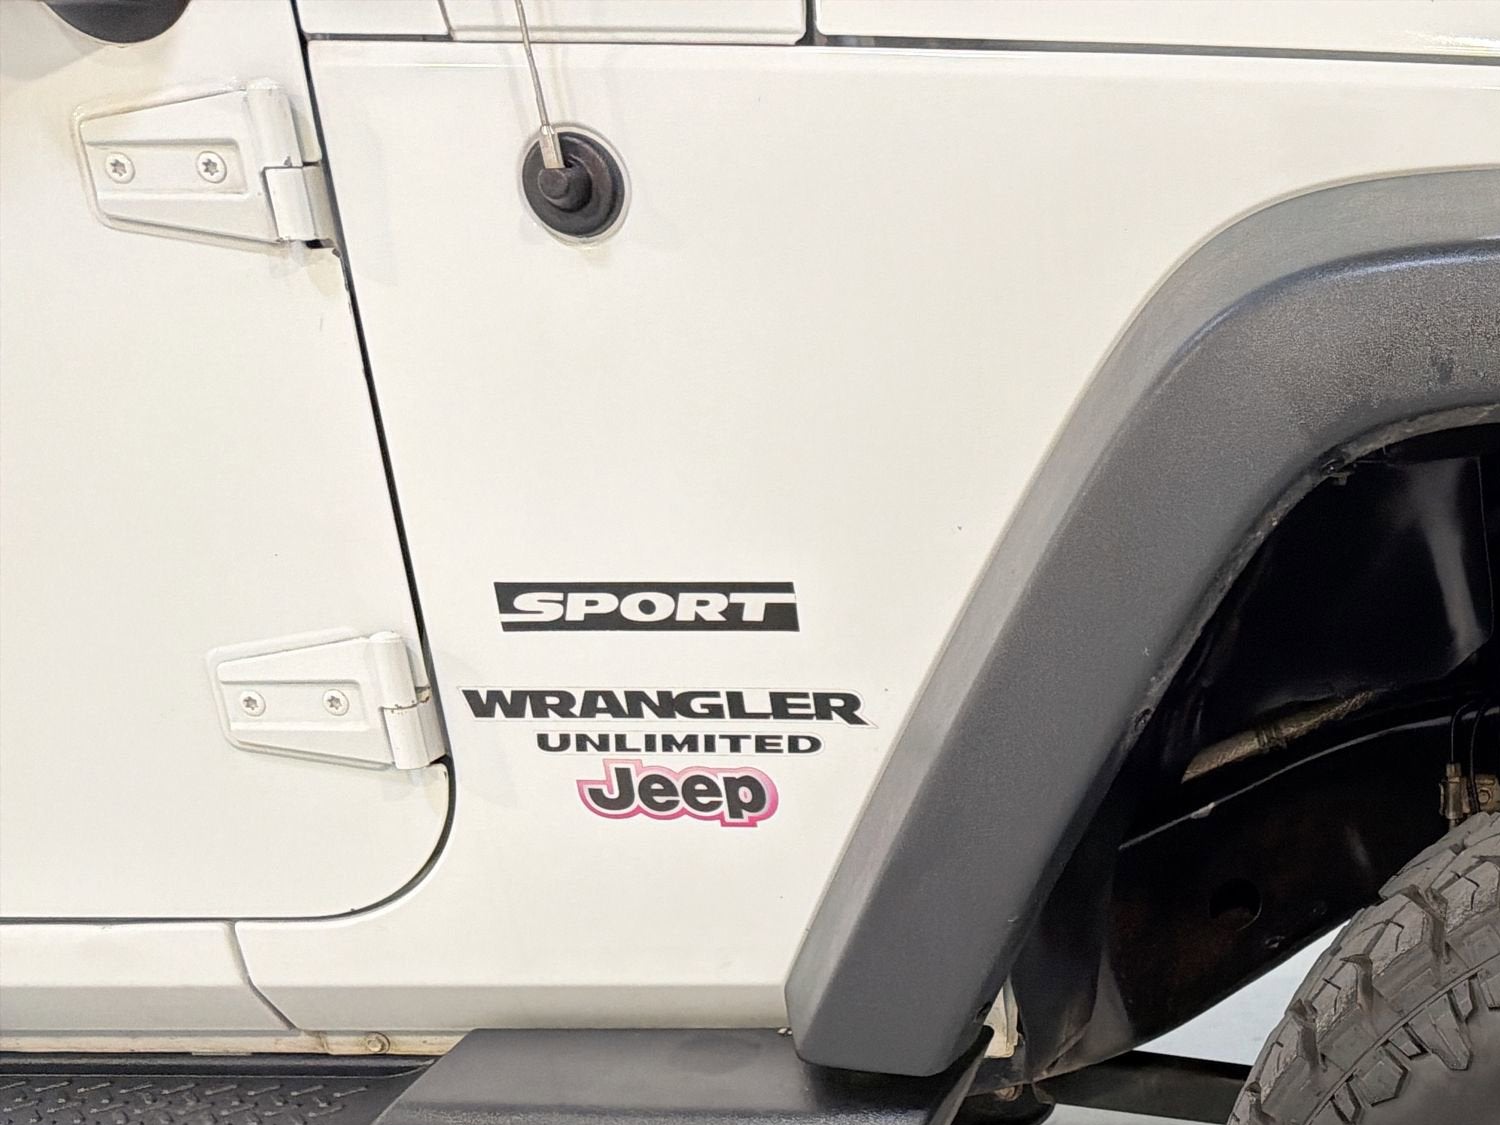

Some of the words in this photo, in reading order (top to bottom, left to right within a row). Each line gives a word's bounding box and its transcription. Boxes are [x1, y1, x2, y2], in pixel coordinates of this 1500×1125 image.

[499, 591, 798, 623] SPORT
[461, 688, 869, 726] WRANGLER
[536, 732, 823, 754] UNLIMITED
[586, 764, 770, 821] Jeep
